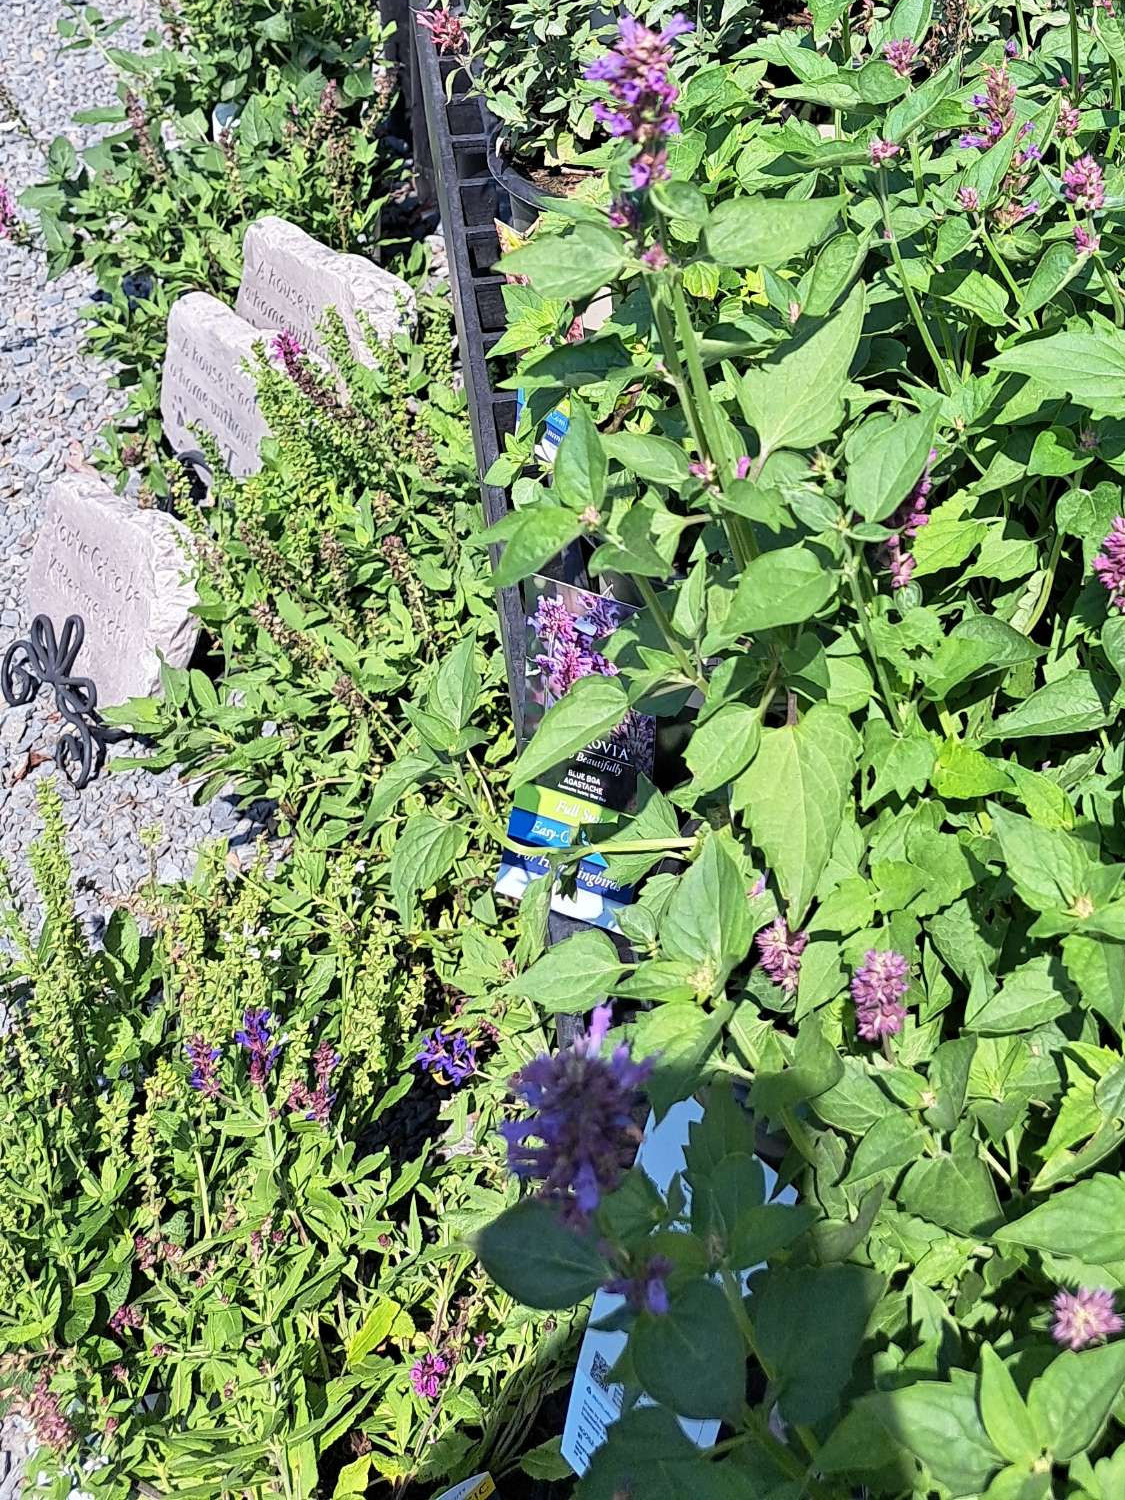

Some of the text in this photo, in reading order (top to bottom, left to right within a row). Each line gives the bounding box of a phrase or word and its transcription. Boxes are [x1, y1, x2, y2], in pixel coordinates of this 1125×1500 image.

[192, 345, 224, 384] house
[178, 368, 209, 402] home
[567, 769, 586, 782] BLUE
[576, 752, 624, 776] Beautifully
[555, 801, 580, 817] Full
